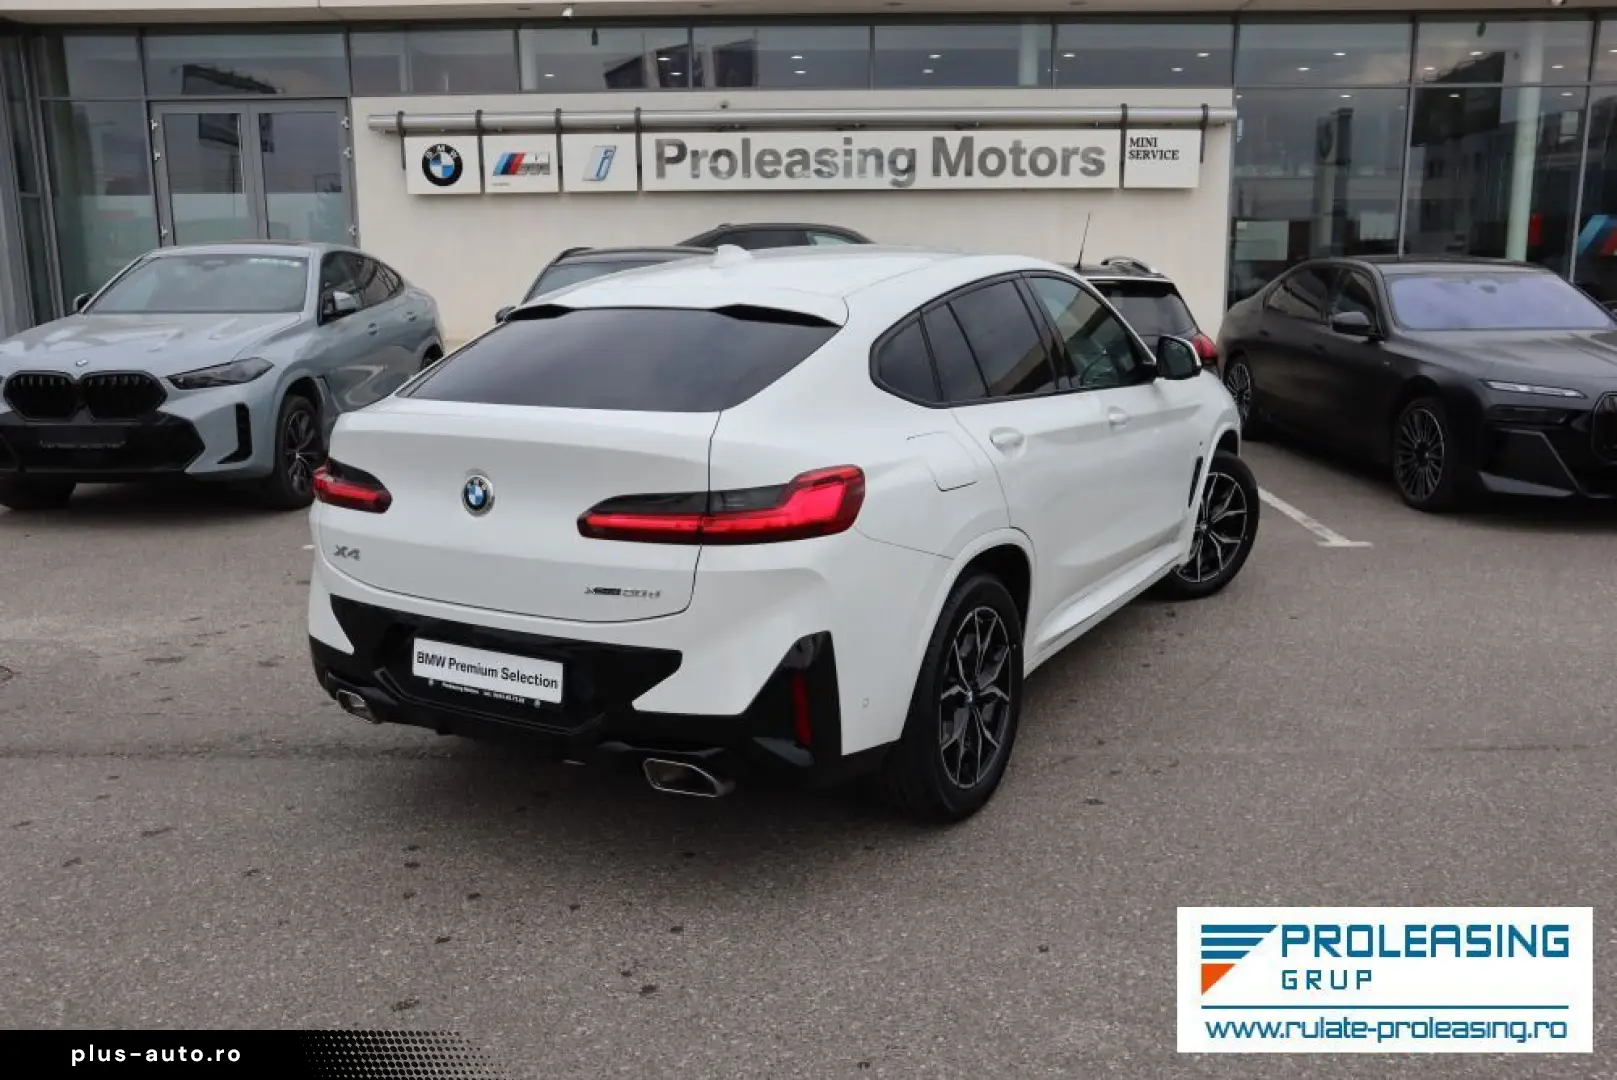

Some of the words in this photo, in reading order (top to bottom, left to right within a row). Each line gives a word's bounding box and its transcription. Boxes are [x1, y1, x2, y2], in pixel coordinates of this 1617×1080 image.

[1128, 136, 1158, 148] MINI
[655, 137, 917, 188] Proleasing
[931, 134, 1105, 178] Motors
[1128, 149, 1180, 161] SERVICE
[333, 544, 361, 562] X4
[416, 651, 446, 669] BMW
[448, 657, 499, 678] Premium
[500, 667, 559, 690] Selection
